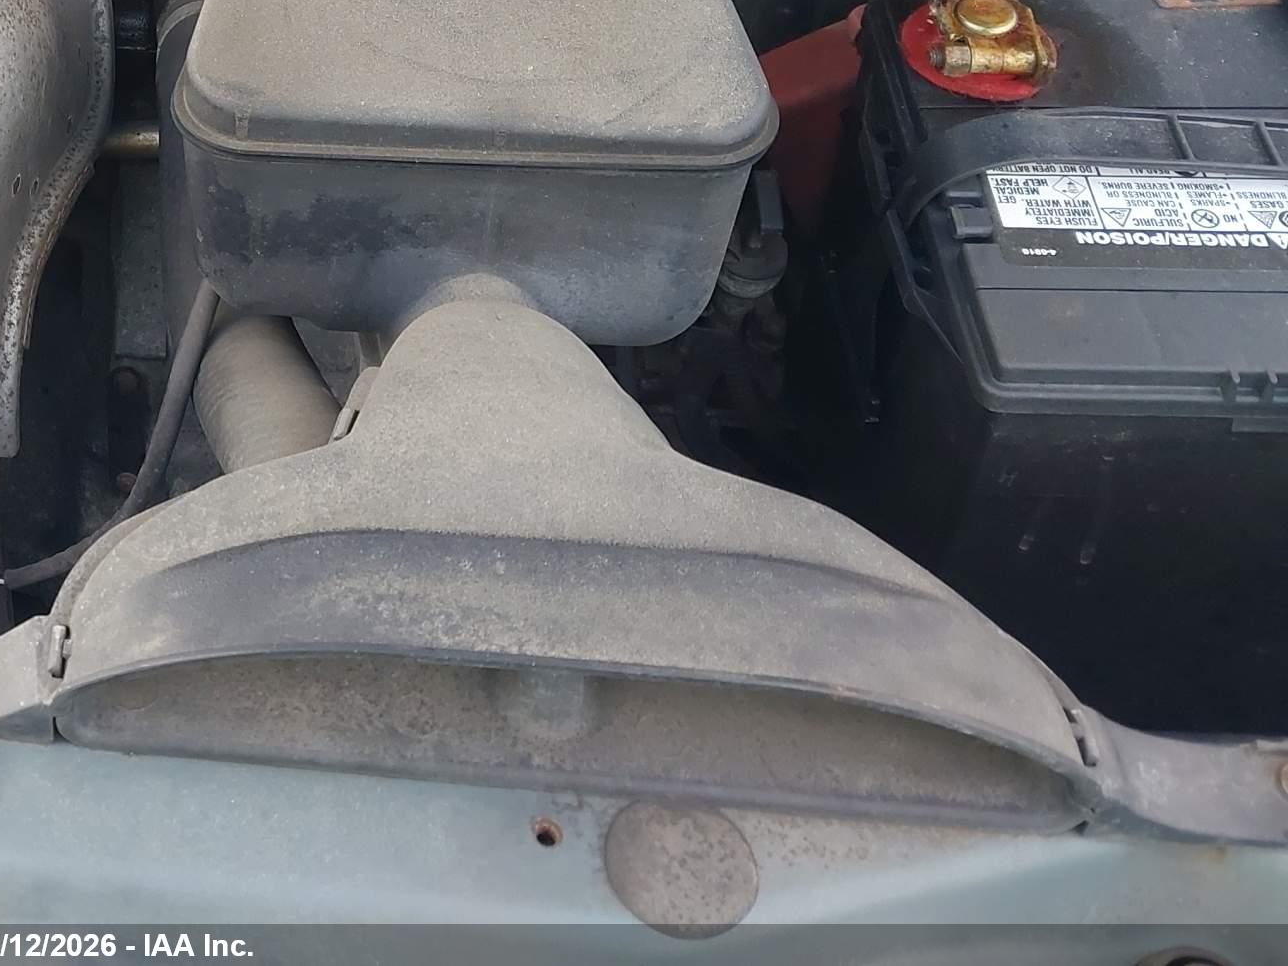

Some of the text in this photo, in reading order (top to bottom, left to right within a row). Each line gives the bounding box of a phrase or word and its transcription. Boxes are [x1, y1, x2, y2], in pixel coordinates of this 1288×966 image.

[1032, 165, 1057, 173] OPEN
[1058, 165, 1078, 173] NOT
[990, 177, 1049, 187] HELP FAST.
[1133, 182, 1170, 190] SEVERE
[993, 187, 1039, 195] MEDICAL
[1105, 190, 1173, 199] BLINDNESS OR
[1235, 191, 1287, 200] BLINDNESS
[997, 195, 1017, 204] GET
[1021, 198, 1092, 208] WITH WATER.
[1125, 199, 1177, 208] CAN CAUSE
[1249, 200, 1284, 208] GASES
[1025, 207, 1093, 216] IMMEDIATELY
[1153, 208, 1179, 218] ACID
[1035, 216, 1098, 226] FLUSH EYES
[1133, 218, 1183, 227] SULFURIC
[1222, 214, 1238, 222] NO
[1076, 232, 1268, 246] DANGER/POISON
